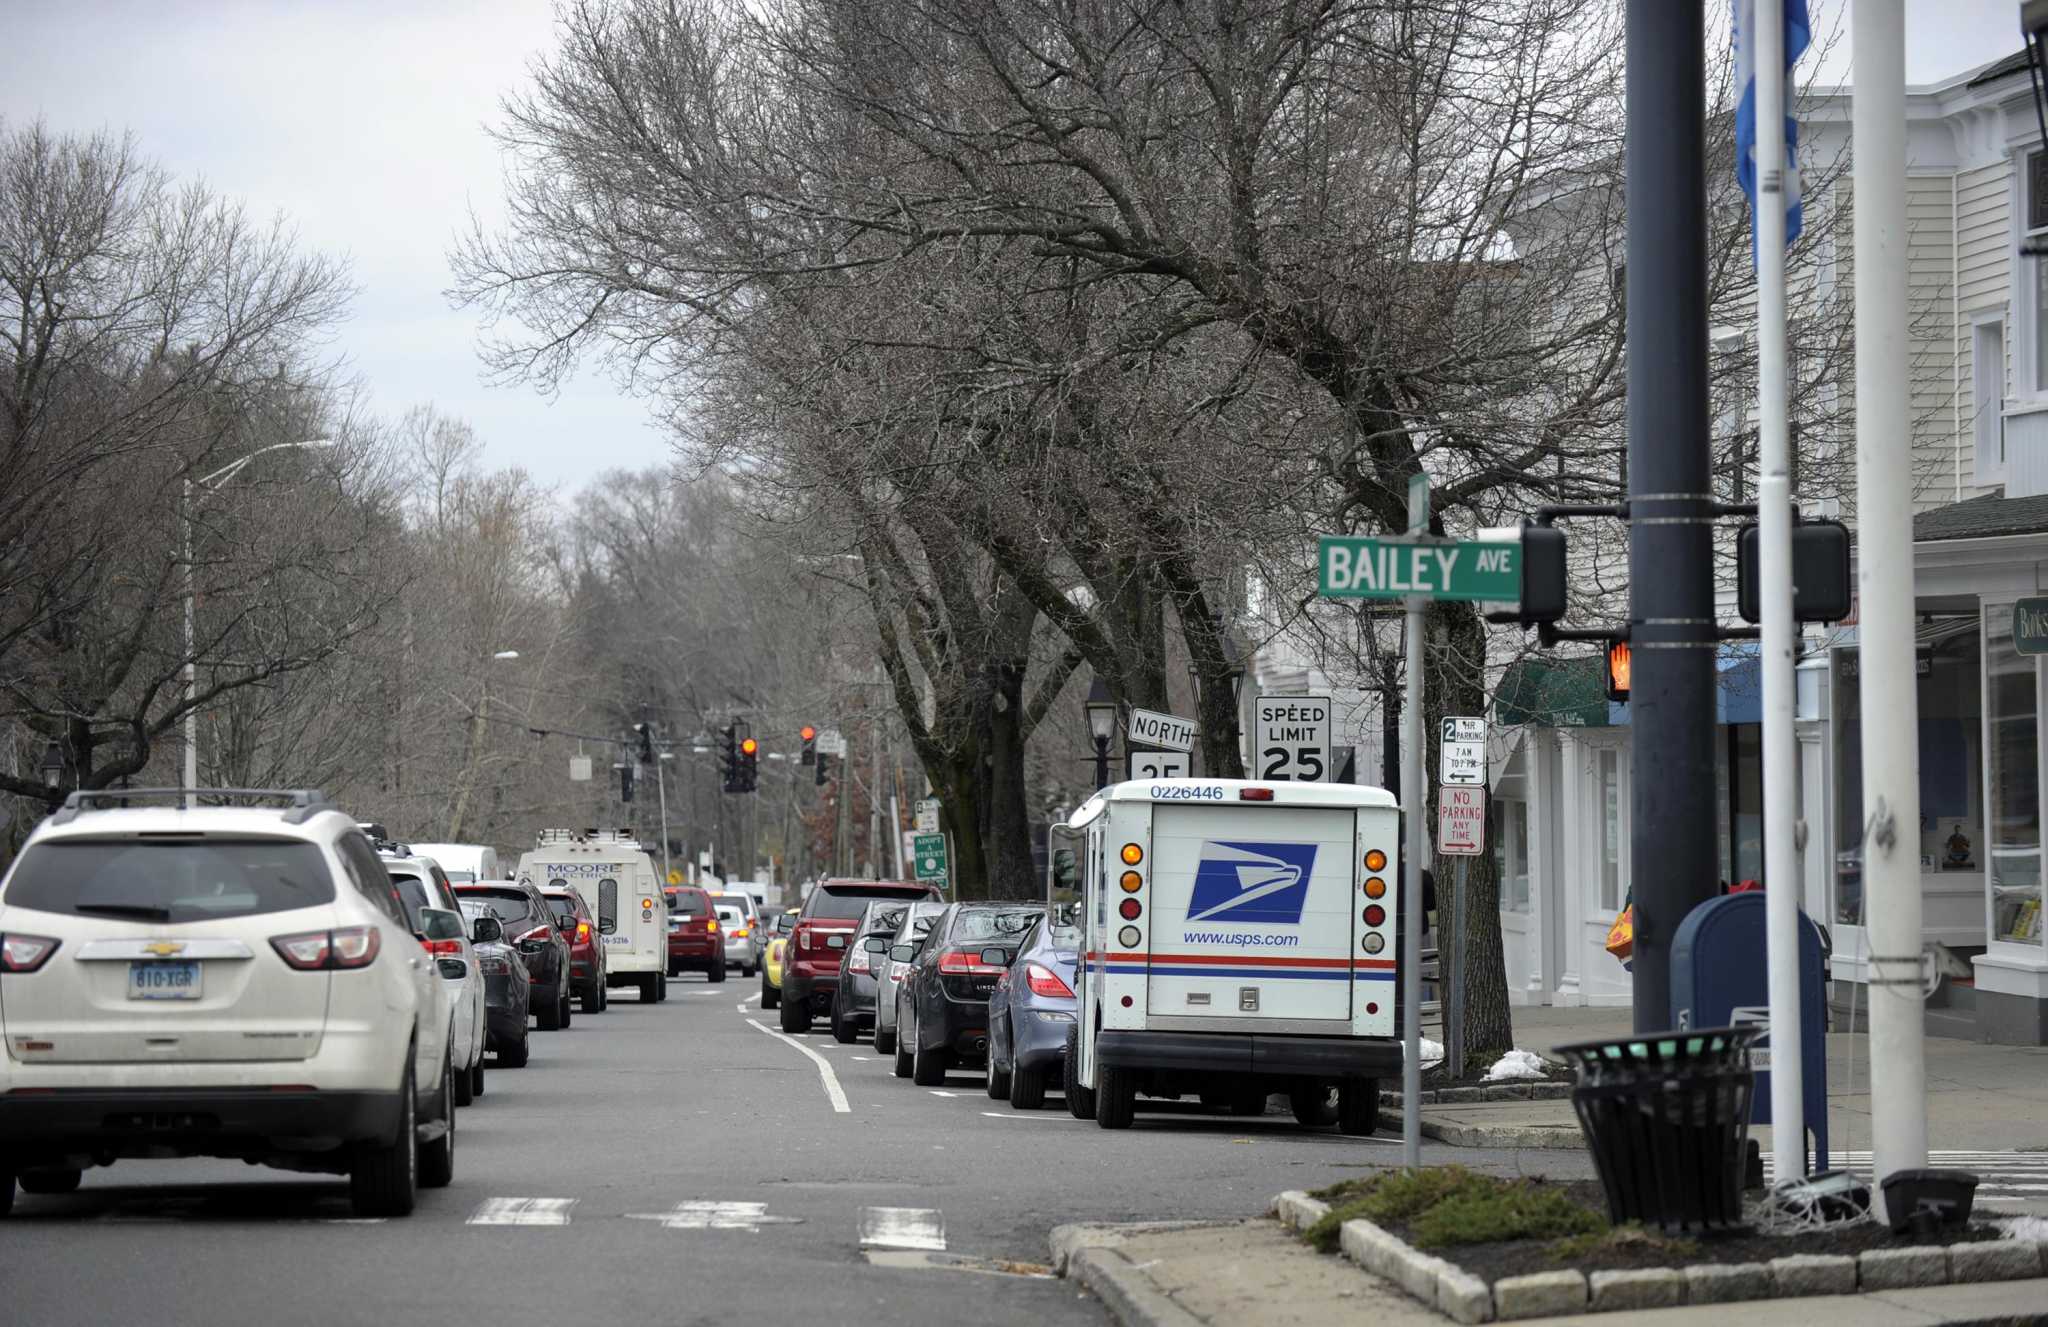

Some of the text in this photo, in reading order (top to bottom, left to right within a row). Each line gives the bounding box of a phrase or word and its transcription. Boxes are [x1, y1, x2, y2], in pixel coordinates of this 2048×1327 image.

[1327, 546, 1512, 592] BAILEY AVE
[1262, 707, 1325, 722] SPEED
[1134, 716, 1192, 745] NORTH
[1444, 722, 1455, 740] 2
[1464, 721, 1476, 730] HR
[1269, 727, 1317, 742] LIMIT
[1456, 731, 1483, 741] PARKING
[1462, 748, 1472, 756] AM
[1262, 747, 1324, 782] 25
[1150, 785, 1224, 800] 0226446
[1453, 791, 1470, 805] NO
[1442, 806, 1481, 820] PARKING
[1452, 820, 1470, 830] ANY
[1451, 831, 1470, 840] TIME
[547, 863, 623, 873] MOORE
[1183, 932, 1299, 948] www.usps.com
